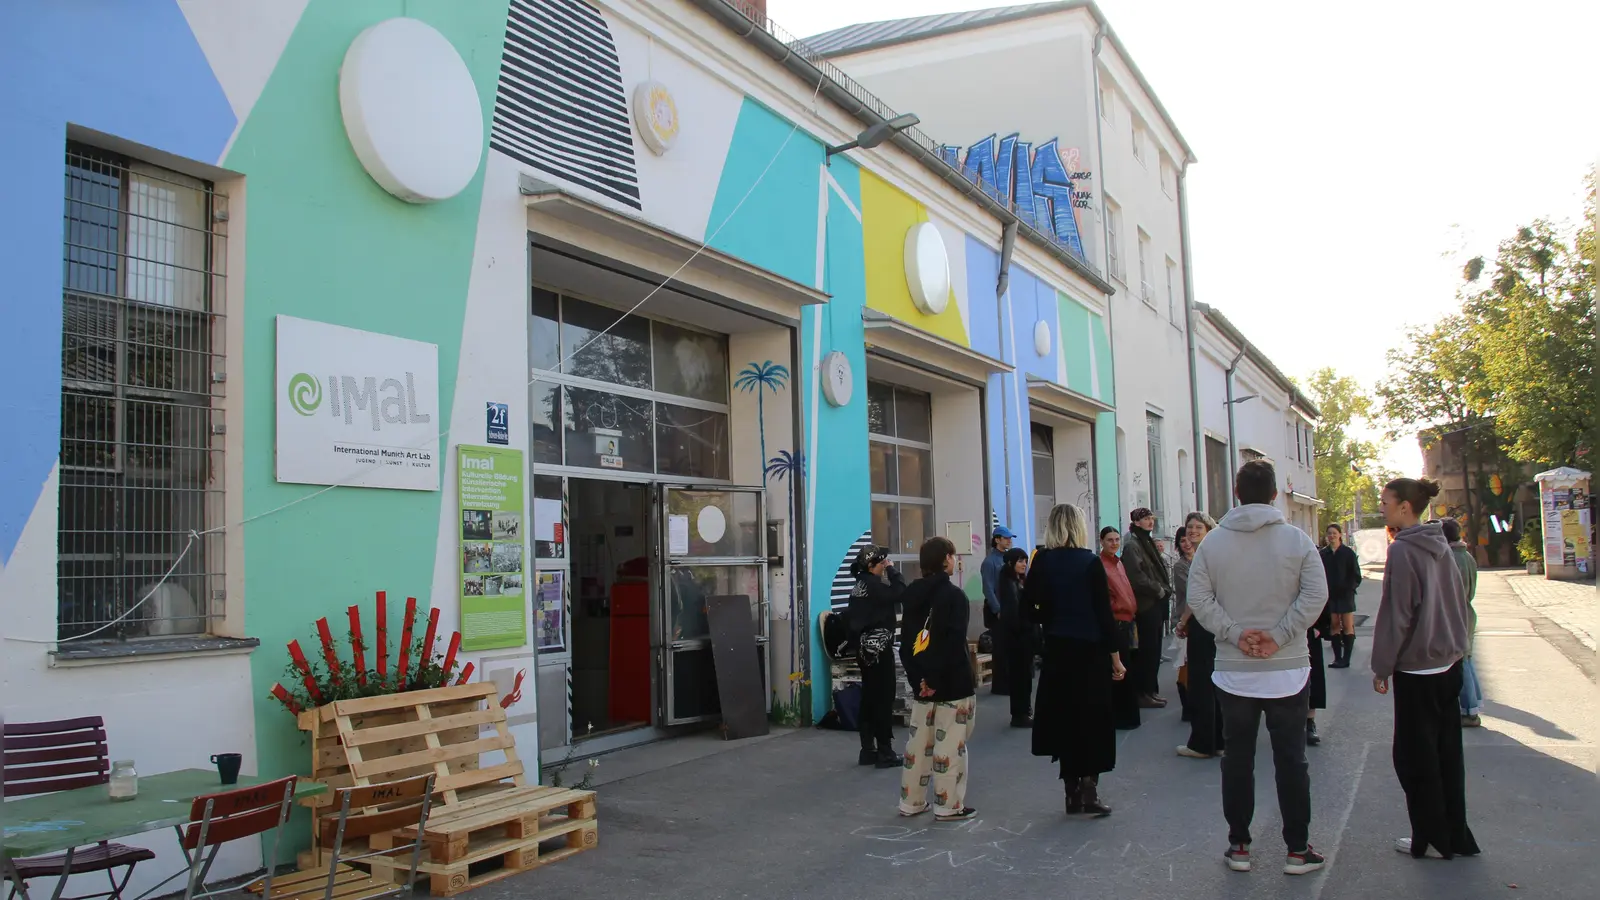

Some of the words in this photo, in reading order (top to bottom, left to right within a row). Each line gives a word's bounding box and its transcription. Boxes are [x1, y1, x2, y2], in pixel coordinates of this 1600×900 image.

[491, 405, 505, 425] 2f
[334, 445, 379, 456] International
[381, 449, 404, 458] Munich
[462, 454, 494, 470] Imal
[372, 786, 403, 799] IMAL
